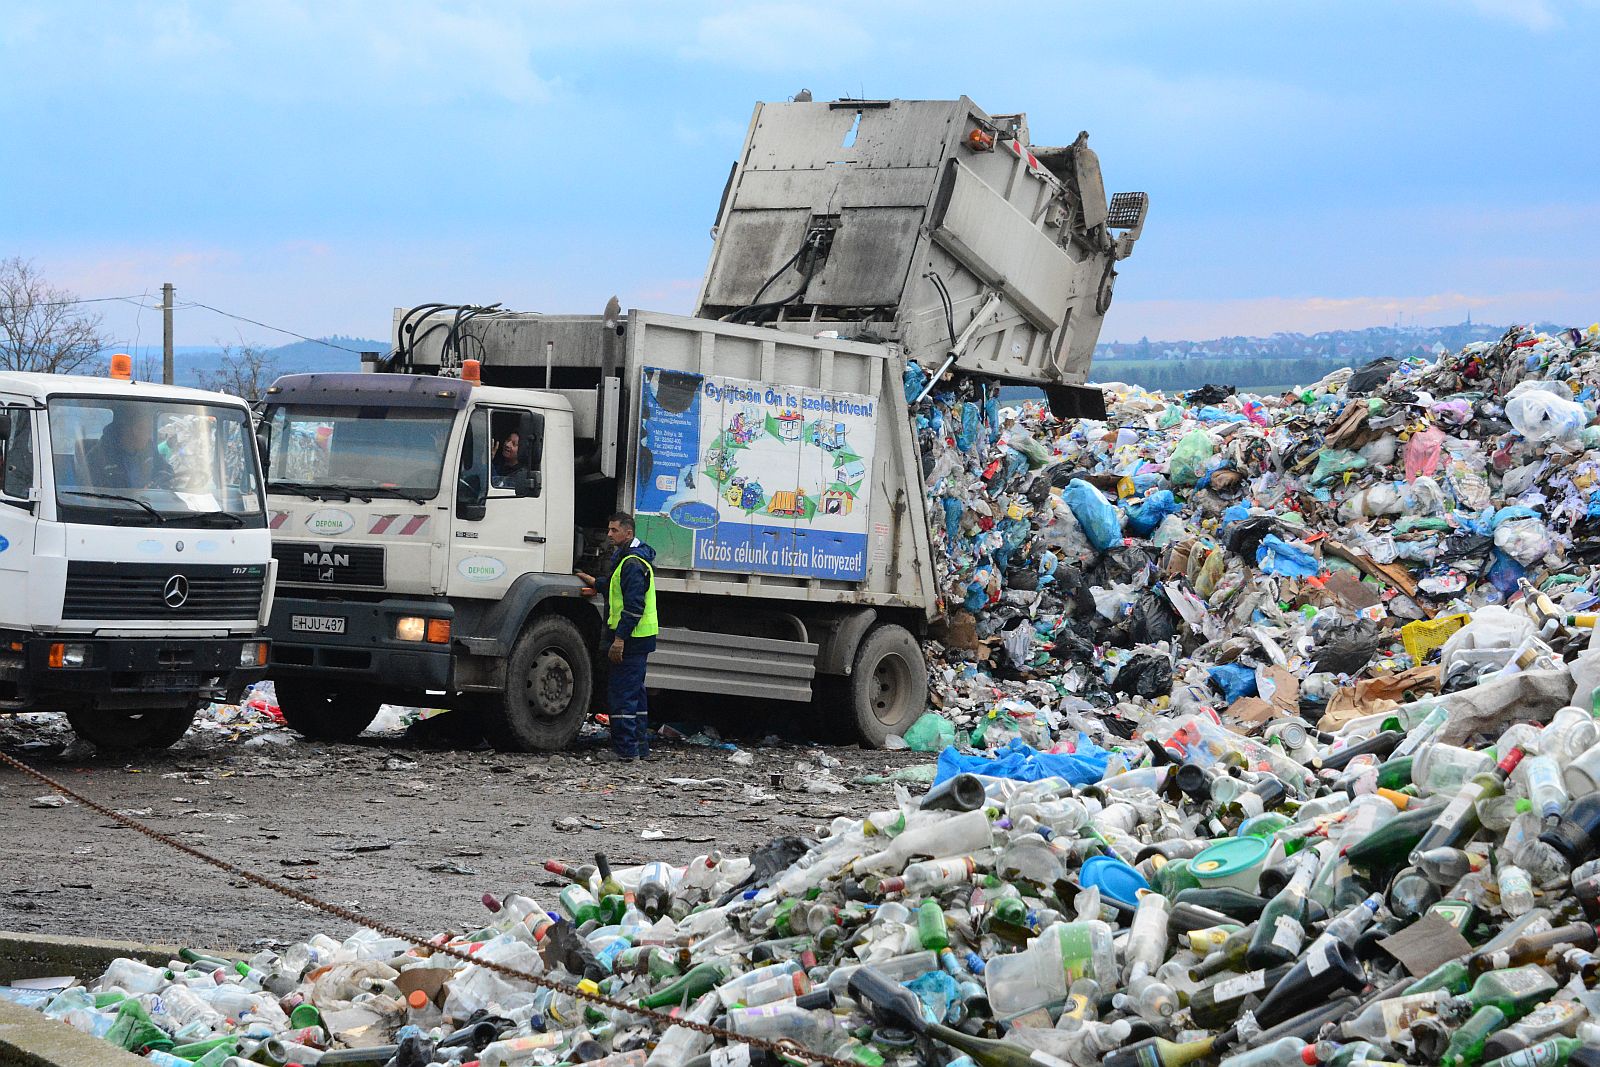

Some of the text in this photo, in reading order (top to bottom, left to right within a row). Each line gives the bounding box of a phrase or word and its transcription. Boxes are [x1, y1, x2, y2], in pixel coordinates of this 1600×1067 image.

[765, 387, 782, 406] Ön
[786, 392, 797, 408] is
[303, 552, 349, 566] MAN
[700, 538, 862, 574] Közös célunk a tiszta környezet!
[299, 617, 343, 631] HJU-437
